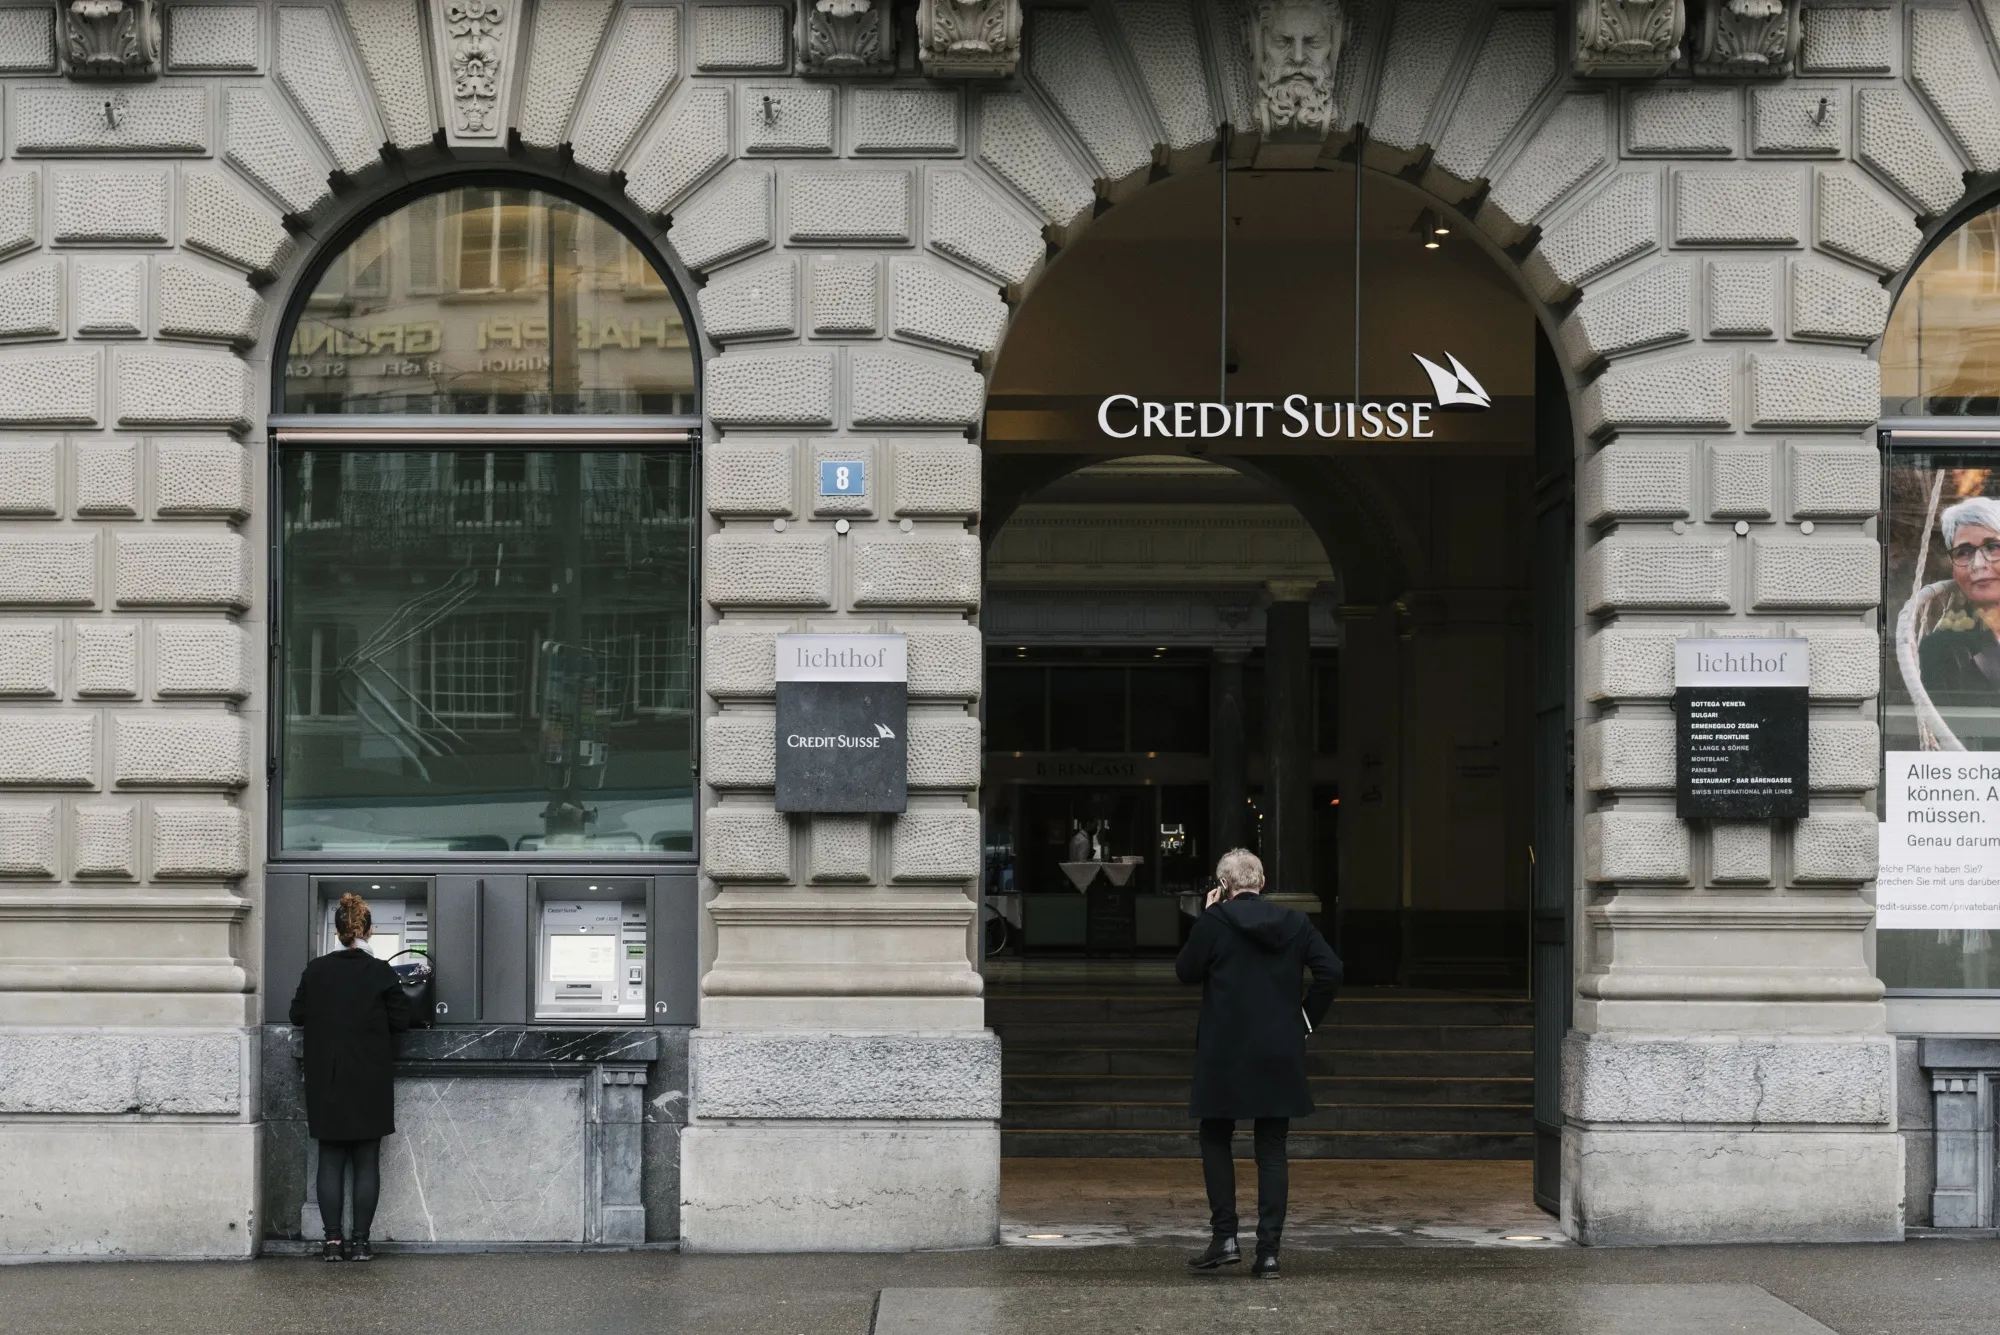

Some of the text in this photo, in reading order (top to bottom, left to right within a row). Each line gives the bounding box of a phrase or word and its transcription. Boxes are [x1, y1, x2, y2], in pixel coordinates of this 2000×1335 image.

[1097, 393, 1434, 439] CREDIT SUISSE
[836, 467, 849, 490] 8
[796, 647, 887, 669] lichthof
[1696, 652, 1787, 673] lichthof
[787, 734, 880, 748] CREDIT SUISSE
[1037, 761, 1136, 776] BRENGASSE
[1907, 764, 2000, 780] Alles scha
[1750, 776, 1793, 784] BÄRENGASSE
[1907, 786, 2000, 802] können. A
[1907, 807, 1986, 824] müssen.
[1907, 835, 2000, 847] Genau darum
[1879, 864, 1983, 874] elche Pläne haben Sie?
[1876, 877, 1914, 888] prechen
[1916, 877, 1931, 886] Sie
[1932, 877, 1947, 886] mit
[1967, 877, 2000, 886] darüber
